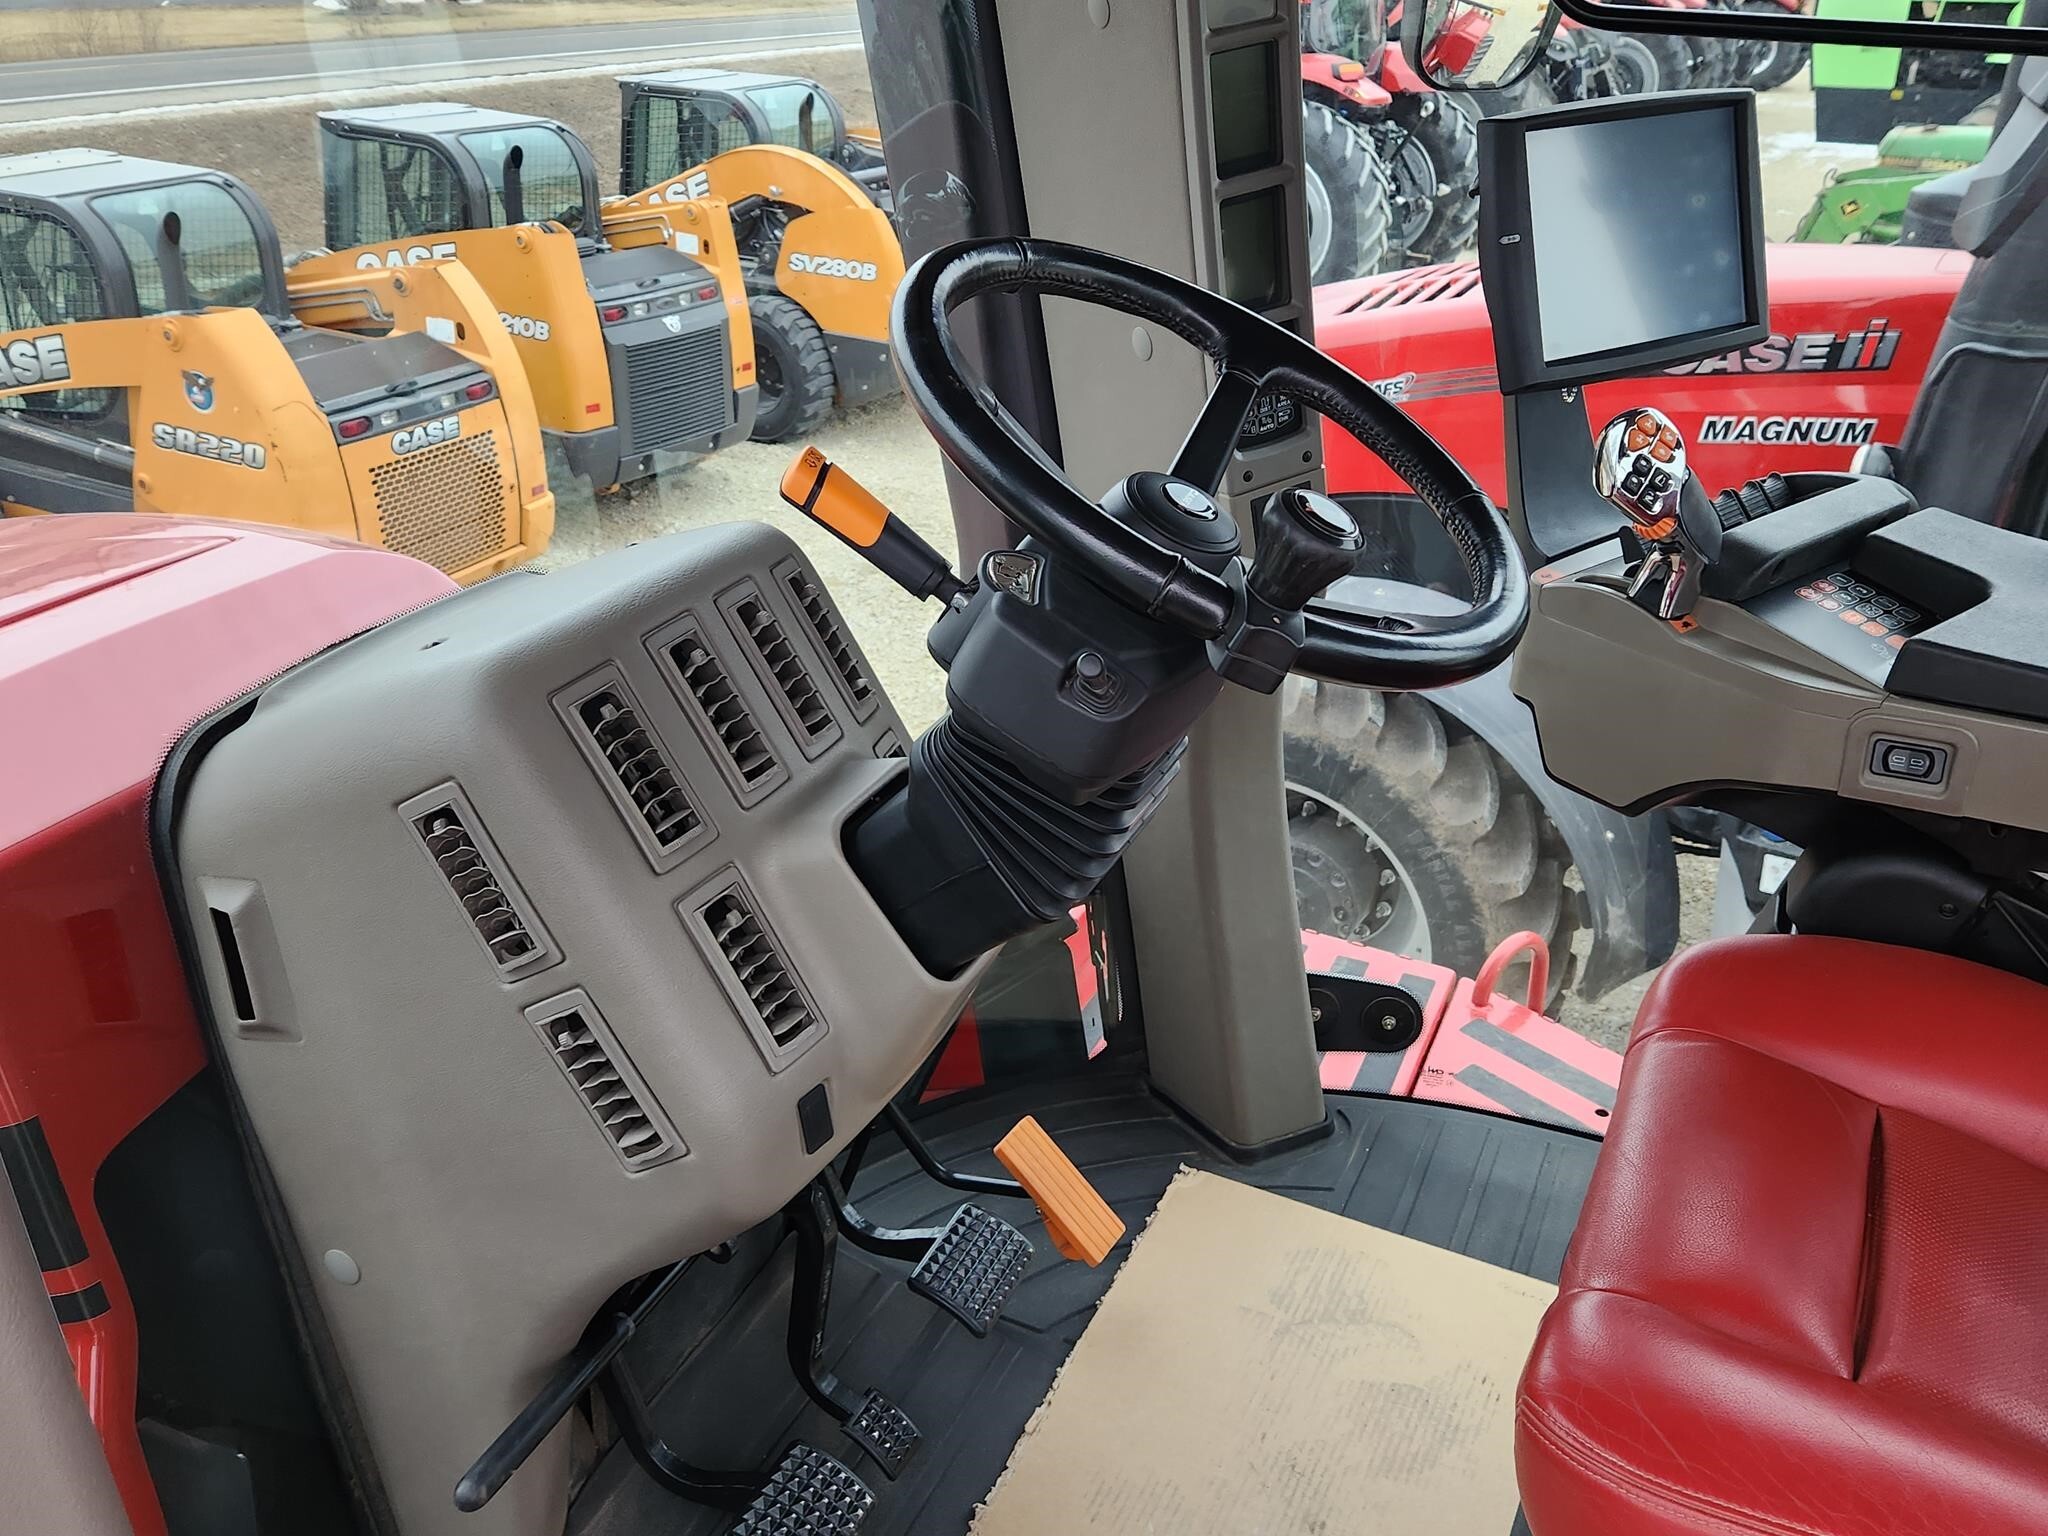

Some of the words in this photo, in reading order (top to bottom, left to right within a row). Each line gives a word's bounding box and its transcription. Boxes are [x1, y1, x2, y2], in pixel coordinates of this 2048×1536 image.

[788, 252, 878, 282] SV280B
[1663, 333, 1836, 375] ASE
[391, 414, 460, 455] CASE
[1259, 423, 1275, 432] AUTO
[1698, 417, 1876, 445] MAGNUM
[152, 422, 266, 470] SR220
